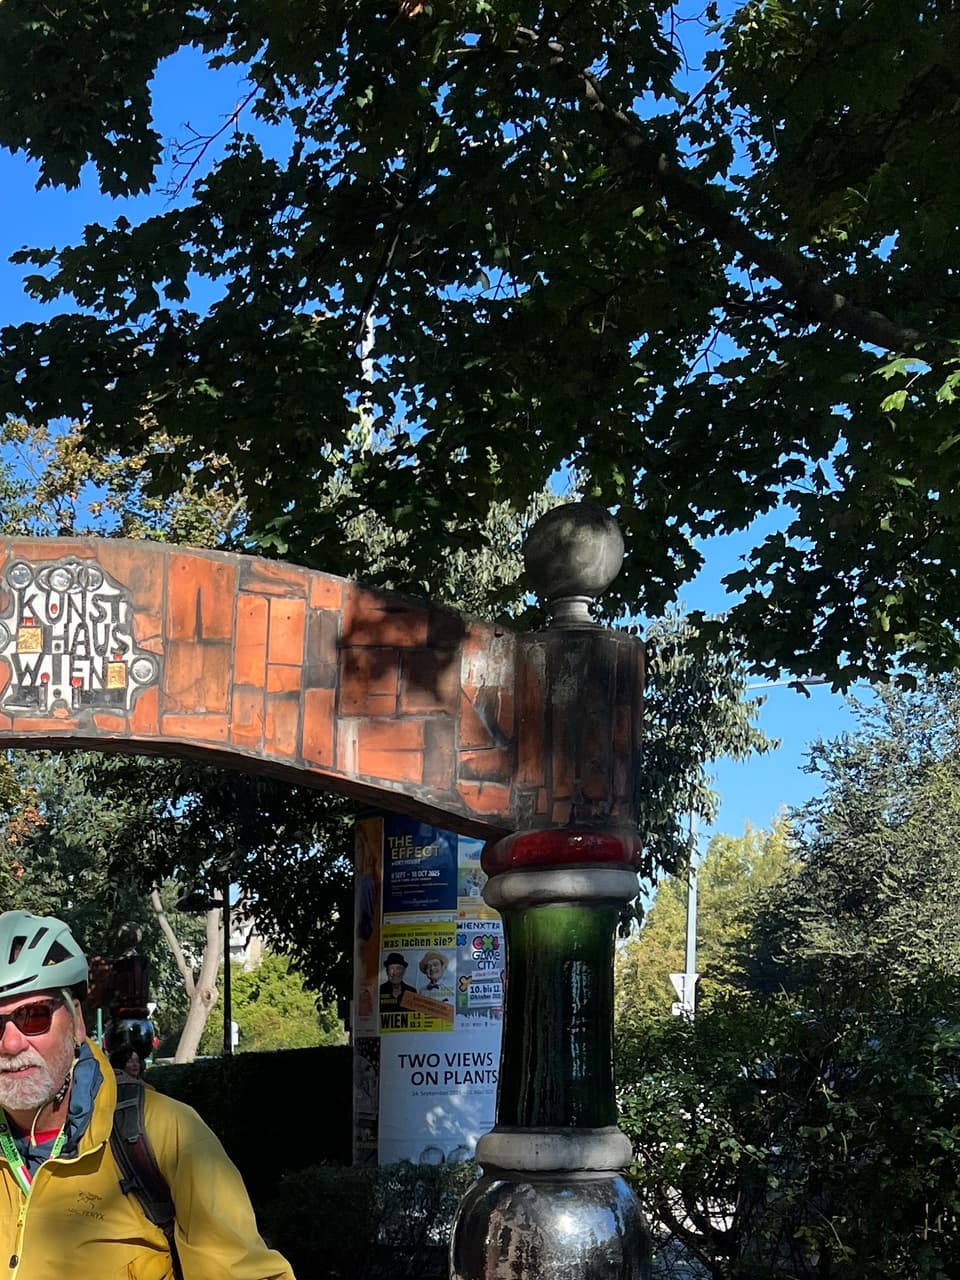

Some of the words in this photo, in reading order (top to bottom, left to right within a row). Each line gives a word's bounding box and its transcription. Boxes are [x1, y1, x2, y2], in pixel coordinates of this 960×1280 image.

[17, 588, 130, 626] KUNST
[43, 622, 130, 657] HAUS
[10, 652, 110, 690] WIEN
[388, 835, 413, 849] THE
[391, 845, 440, 860] EFFECT
[401, 938, 430, 947] lachen
[381, 1012, 409, 1028] WIEN
[398, 1053, 440, 1069] TWO
[444, 1052, 493, 1067] VIEWS
[411, 1071, 438, 1086] ON
[444, 1069, 498, 1085] PLANTS
